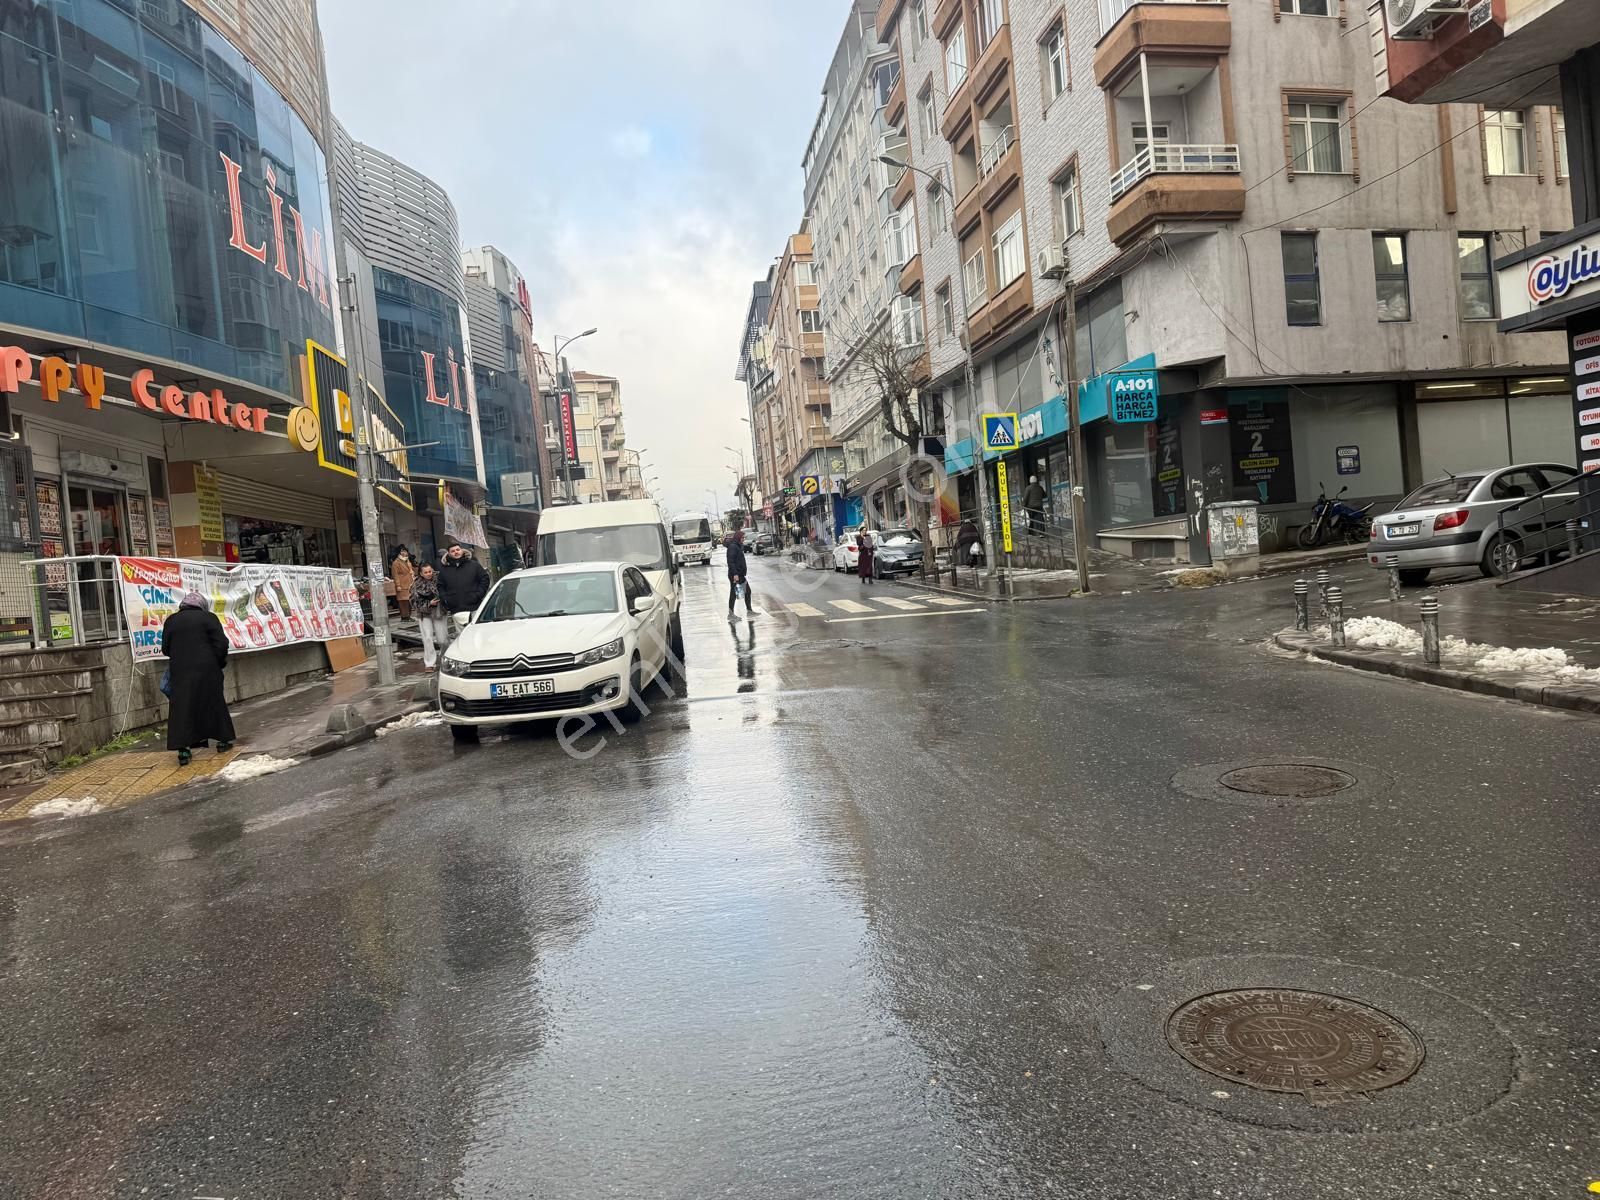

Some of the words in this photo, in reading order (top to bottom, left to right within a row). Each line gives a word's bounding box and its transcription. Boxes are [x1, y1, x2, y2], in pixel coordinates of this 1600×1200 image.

[1533, 247, 1600, 297] oylu
[1576, 335, 1600, 346] FOTOKO
[131, 368, 269, 433] Center
[1116, 391, 1153, 401] HARCA
[1117, 401, 1154, 411] HARCA
[561, 394, 573, 458] PLAYSTATION
[1251, 432, 1263, 452] 2
[133, 630, 163, 648] FIRS
[497, 684, 509, 696] 34
[512, 683, 530, 694] EAT
[533, 681, 552, 692] 566
